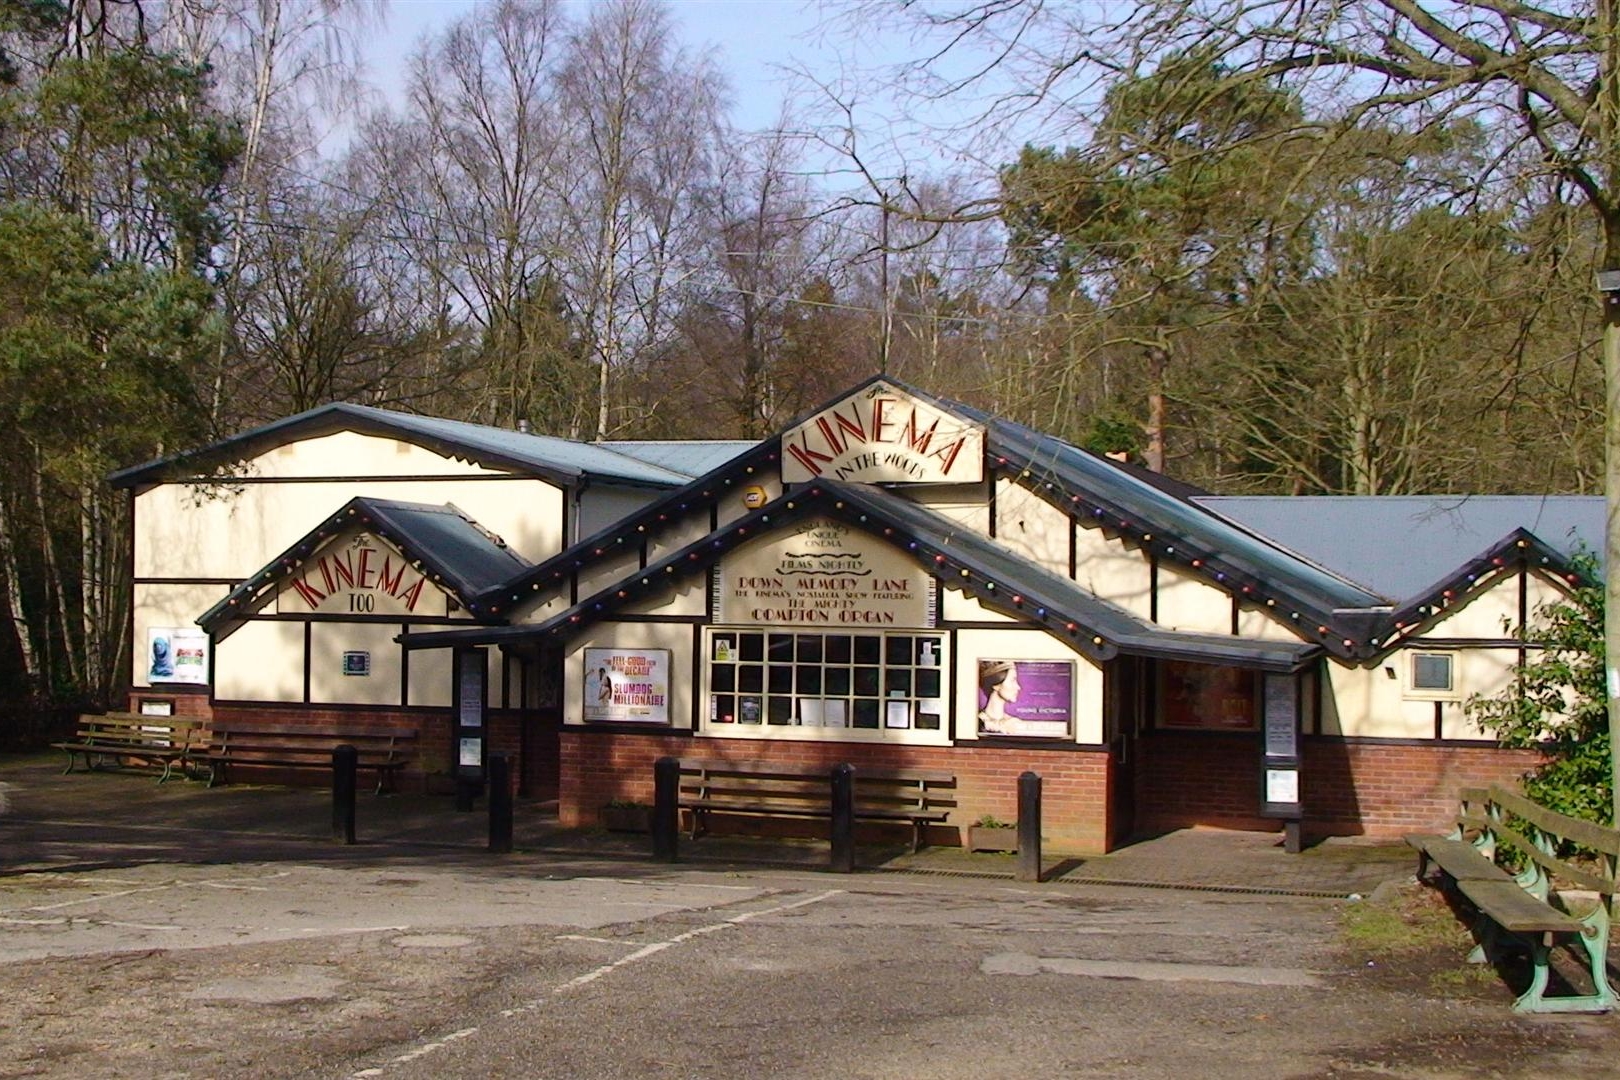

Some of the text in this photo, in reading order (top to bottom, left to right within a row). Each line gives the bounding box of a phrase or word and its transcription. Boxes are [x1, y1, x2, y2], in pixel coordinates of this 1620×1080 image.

[787, 398, 967, 477] KINEMA
[835, 453, 928, 481] IN THE WOODS
[804, 540, 842, 548] CINEMA
[781, 560, 865, 570] FILMS NIGHTLY
[290, 548, 427, 612] KINEMA
[739, 577, 909, 591] DOWN MEMORY LANE
[349, 593, 375, 613] TOO
[814, 600, 856, 609] MIGHTY
[751, 608, 895, 624] COMPTON ORGAN
[614, 683, 653, 695] SLUMDOG
[613, 694, 665, 706] MILLIONAIRE
